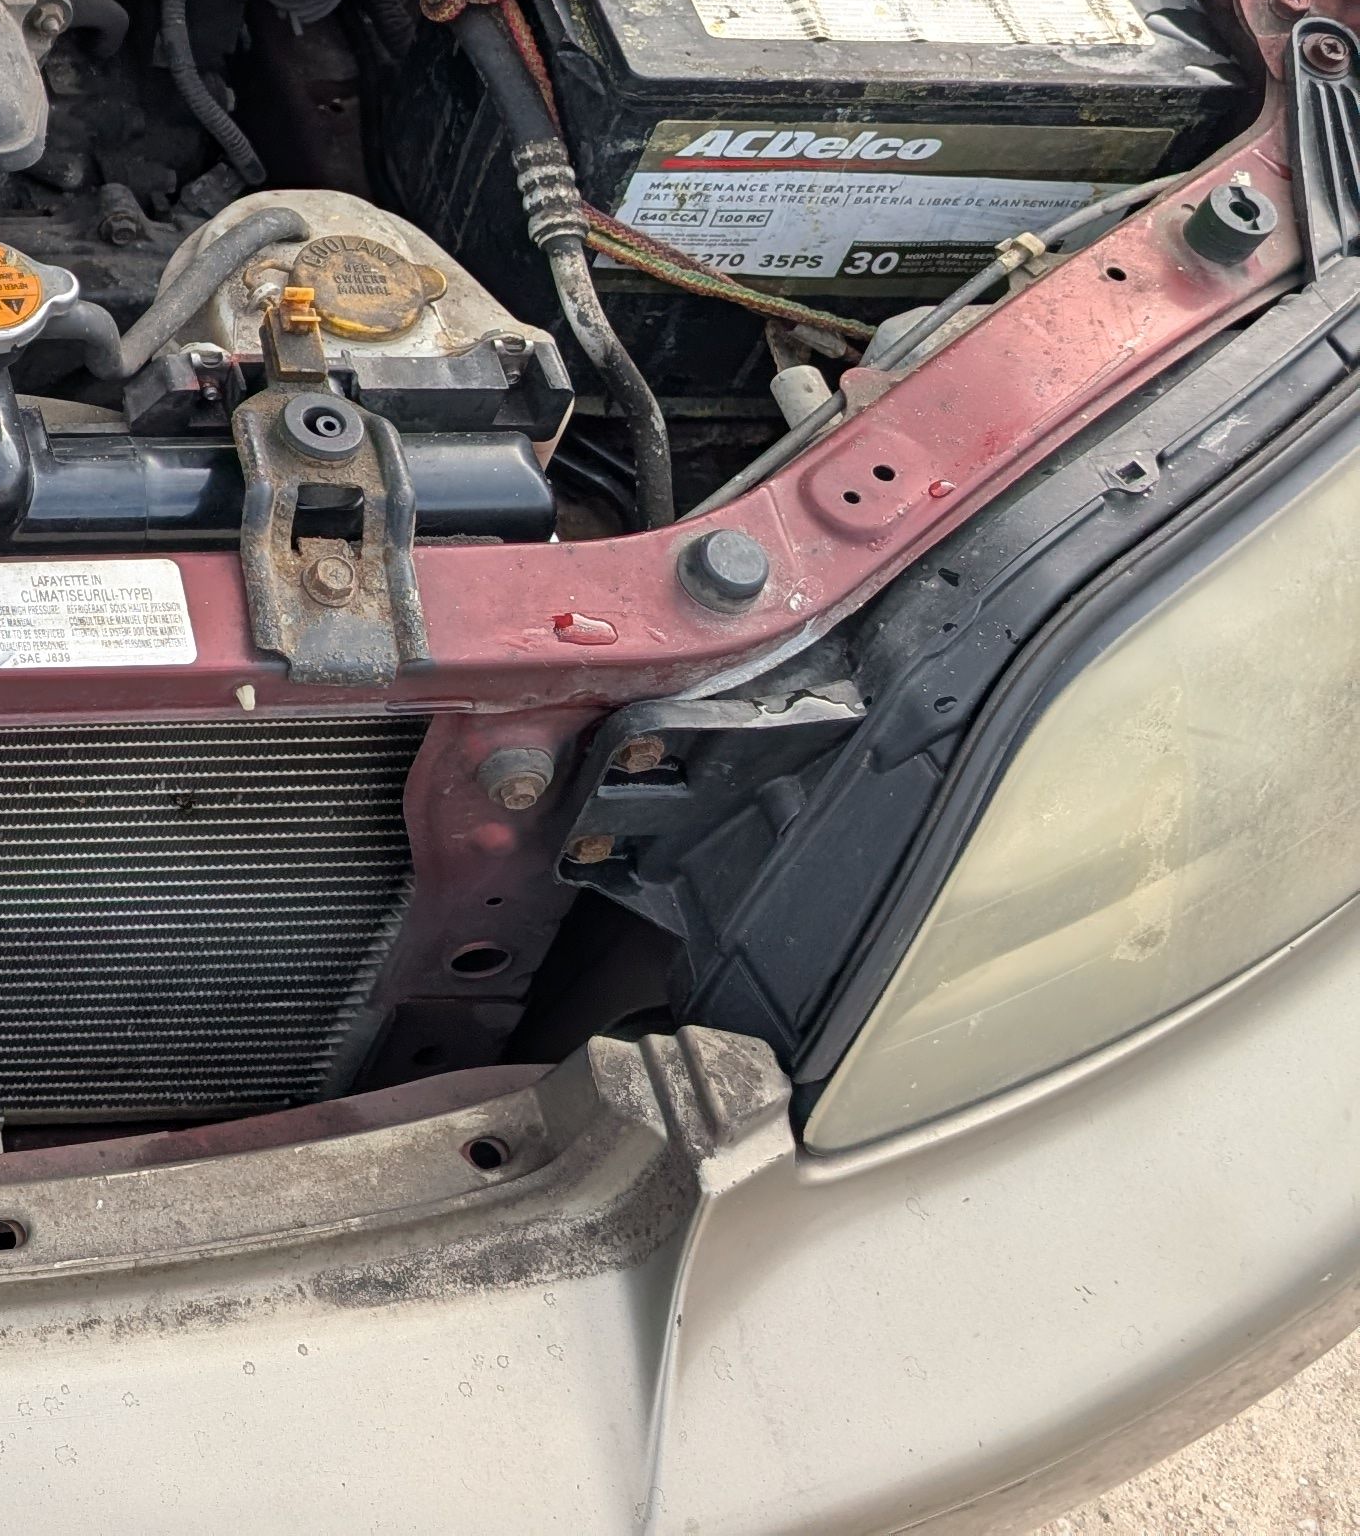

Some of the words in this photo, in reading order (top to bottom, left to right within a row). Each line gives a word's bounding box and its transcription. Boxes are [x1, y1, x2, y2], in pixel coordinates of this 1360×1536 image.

[675, 129, 943, 160] ACDelco
[648, 181, 768, 193] MAINTENANCE
[774, 183, 820, 193] FREE
[823, 184, 899, 194] BATTERY
[643, 193, 711, 203] BATTERIE
[716, 194, 754, 203] SANS
[759, 195, 839, 205] ENTRETIEN
[853, 194, 914, 205] BATERÍA
[918, 196, 964, 206] LIBRE
[965, 197, 982, 207] DE
[639, 213, 666, 221] 640
[670, 213, 698, 222] CCA
[718, 214, 745, 222] 100
[746, 214, 766, 223] RC
[758, 254, 824, 269] 35PS
[843, 251, 900, 275] 30
[30, 575, 89, 587] LAFAYETTE
[91, 575, 102, 585] IN
[21, 587, 153, 603] CLIMATISEUR(LI-TYPE)
[19, 653, 41, 664] SAE
